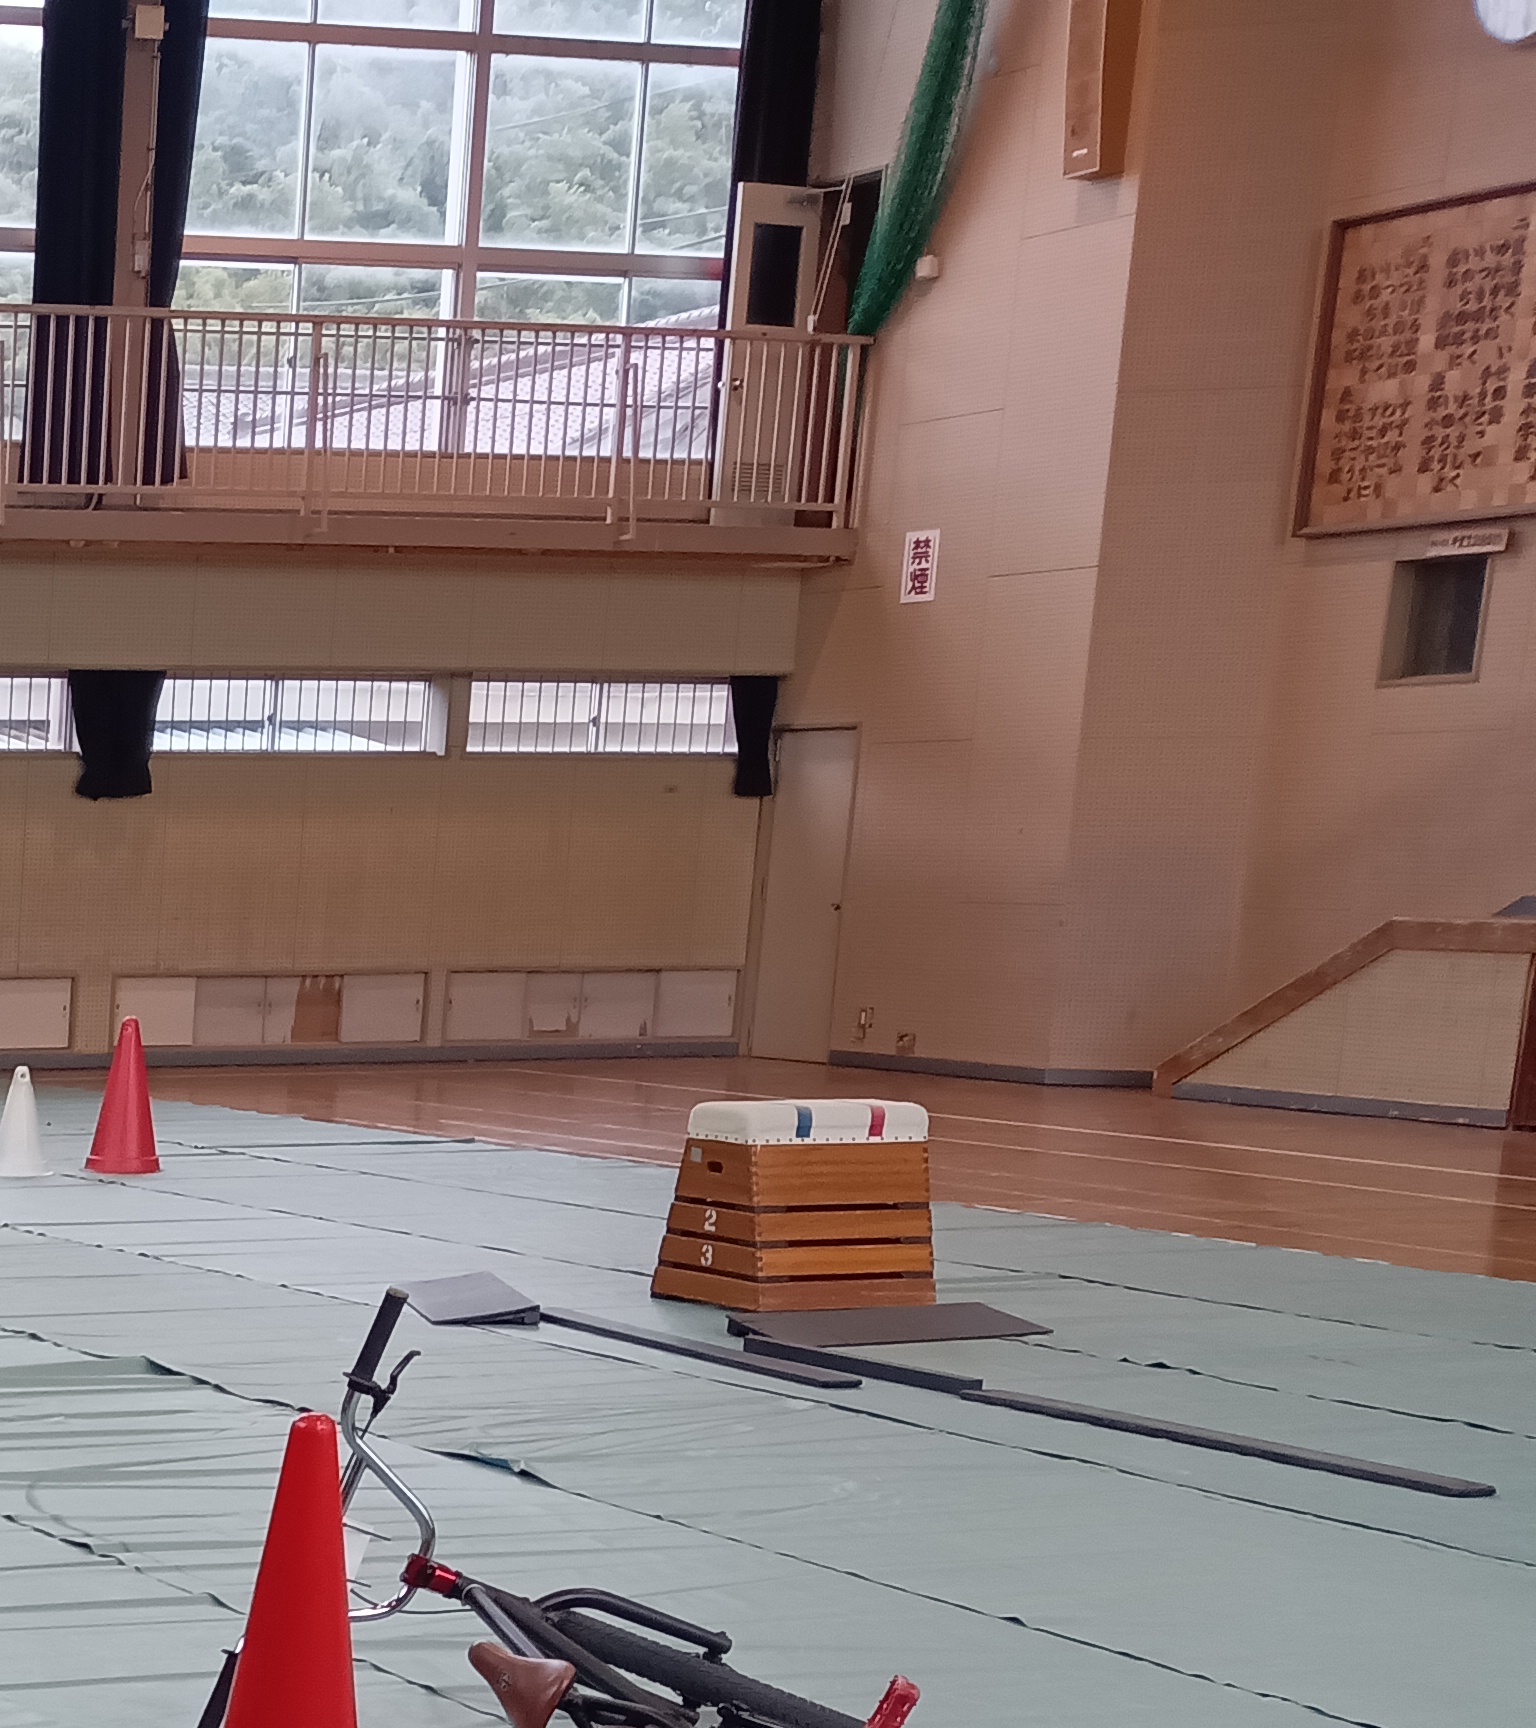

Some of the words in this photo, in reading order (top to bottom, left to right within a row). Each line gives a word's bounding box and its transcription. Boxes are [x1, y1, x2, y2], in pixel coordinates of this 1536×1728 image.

[907, 536, 931, 595] 禁煙
[704, 1208, 717, 1232] 2
[700, 1244, 713, 1267] 3
